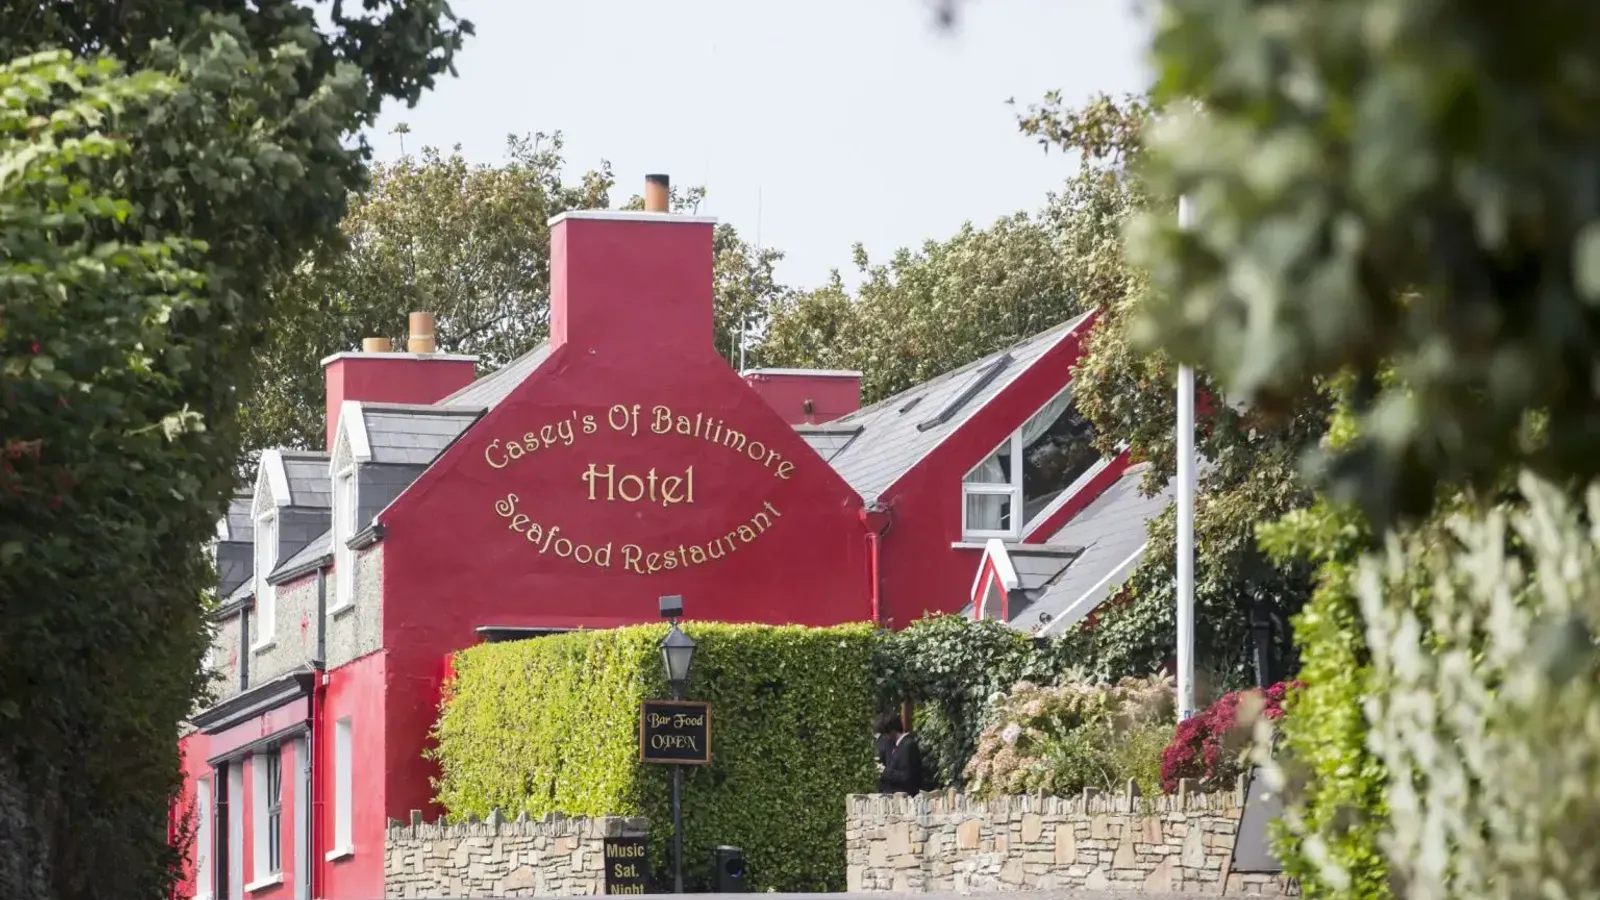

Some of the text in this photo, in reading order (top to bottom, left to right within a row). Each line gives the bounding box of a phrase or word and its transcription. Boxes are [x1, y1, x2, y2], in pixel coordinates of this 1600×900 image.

[485, 404, 796, 480] Casey's Of Baltimore
[582, 463, 694, 506] Hotel
[495, 493, 782, 575] Seafood Restaurant
[647, 712, 703, 728] Bar Food
[651, 734, 700, 752] OPEN
[606, 843, 645, 858] Music
[614, 863, 640, 878] Sat.
